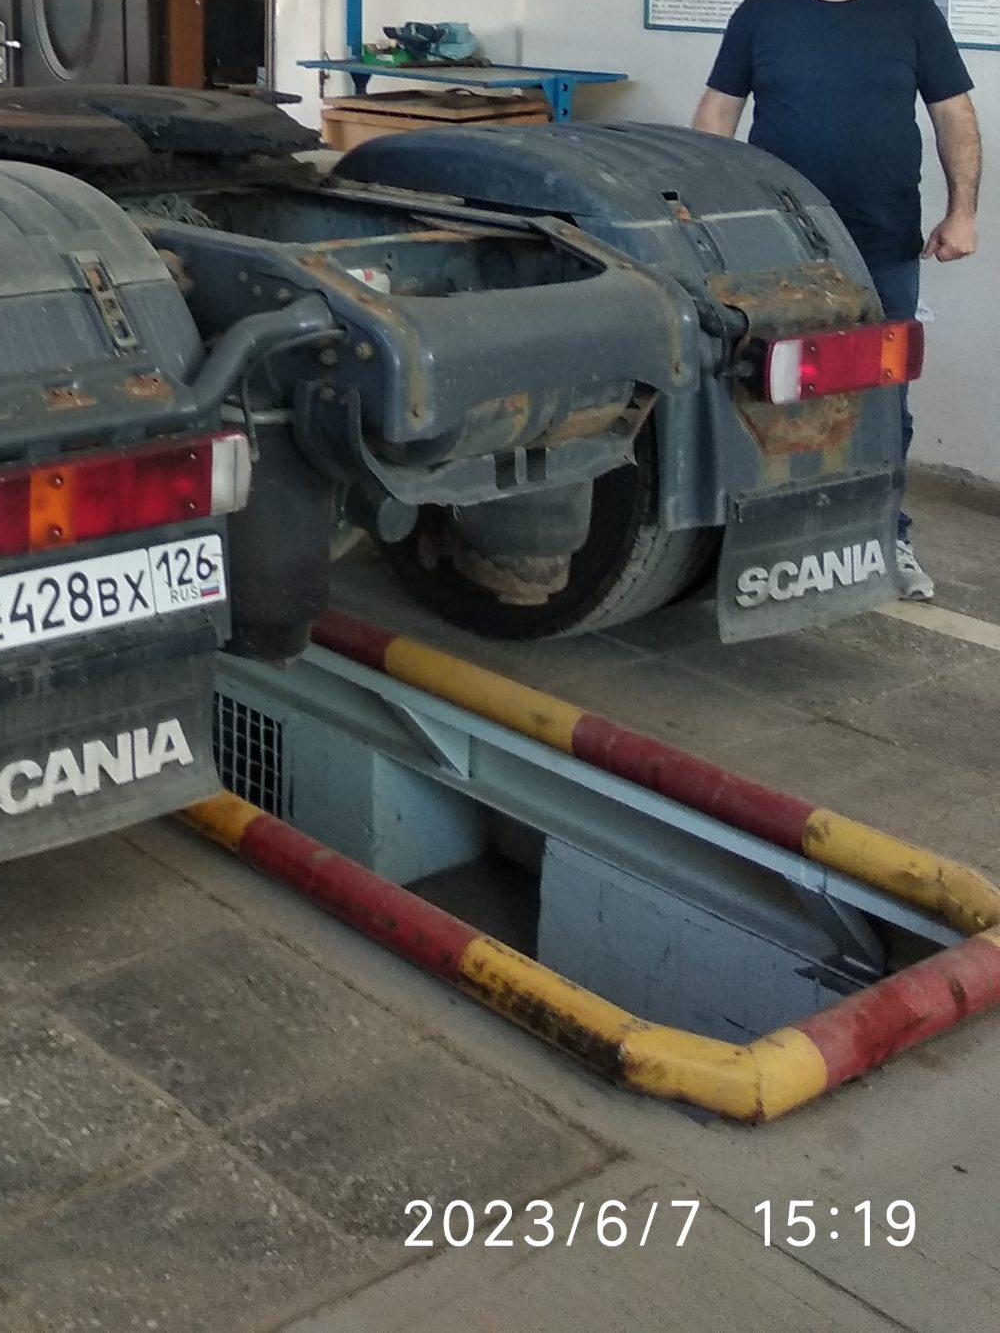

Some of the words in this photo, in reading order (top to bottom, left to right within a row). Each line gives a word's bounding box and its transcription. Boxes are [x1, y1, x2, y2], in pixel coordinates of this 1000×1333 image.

[155, 543, 218, 587] 126
[735, 539, 886, 608] SCANIA
[170, 585, 199, 603] RUS
